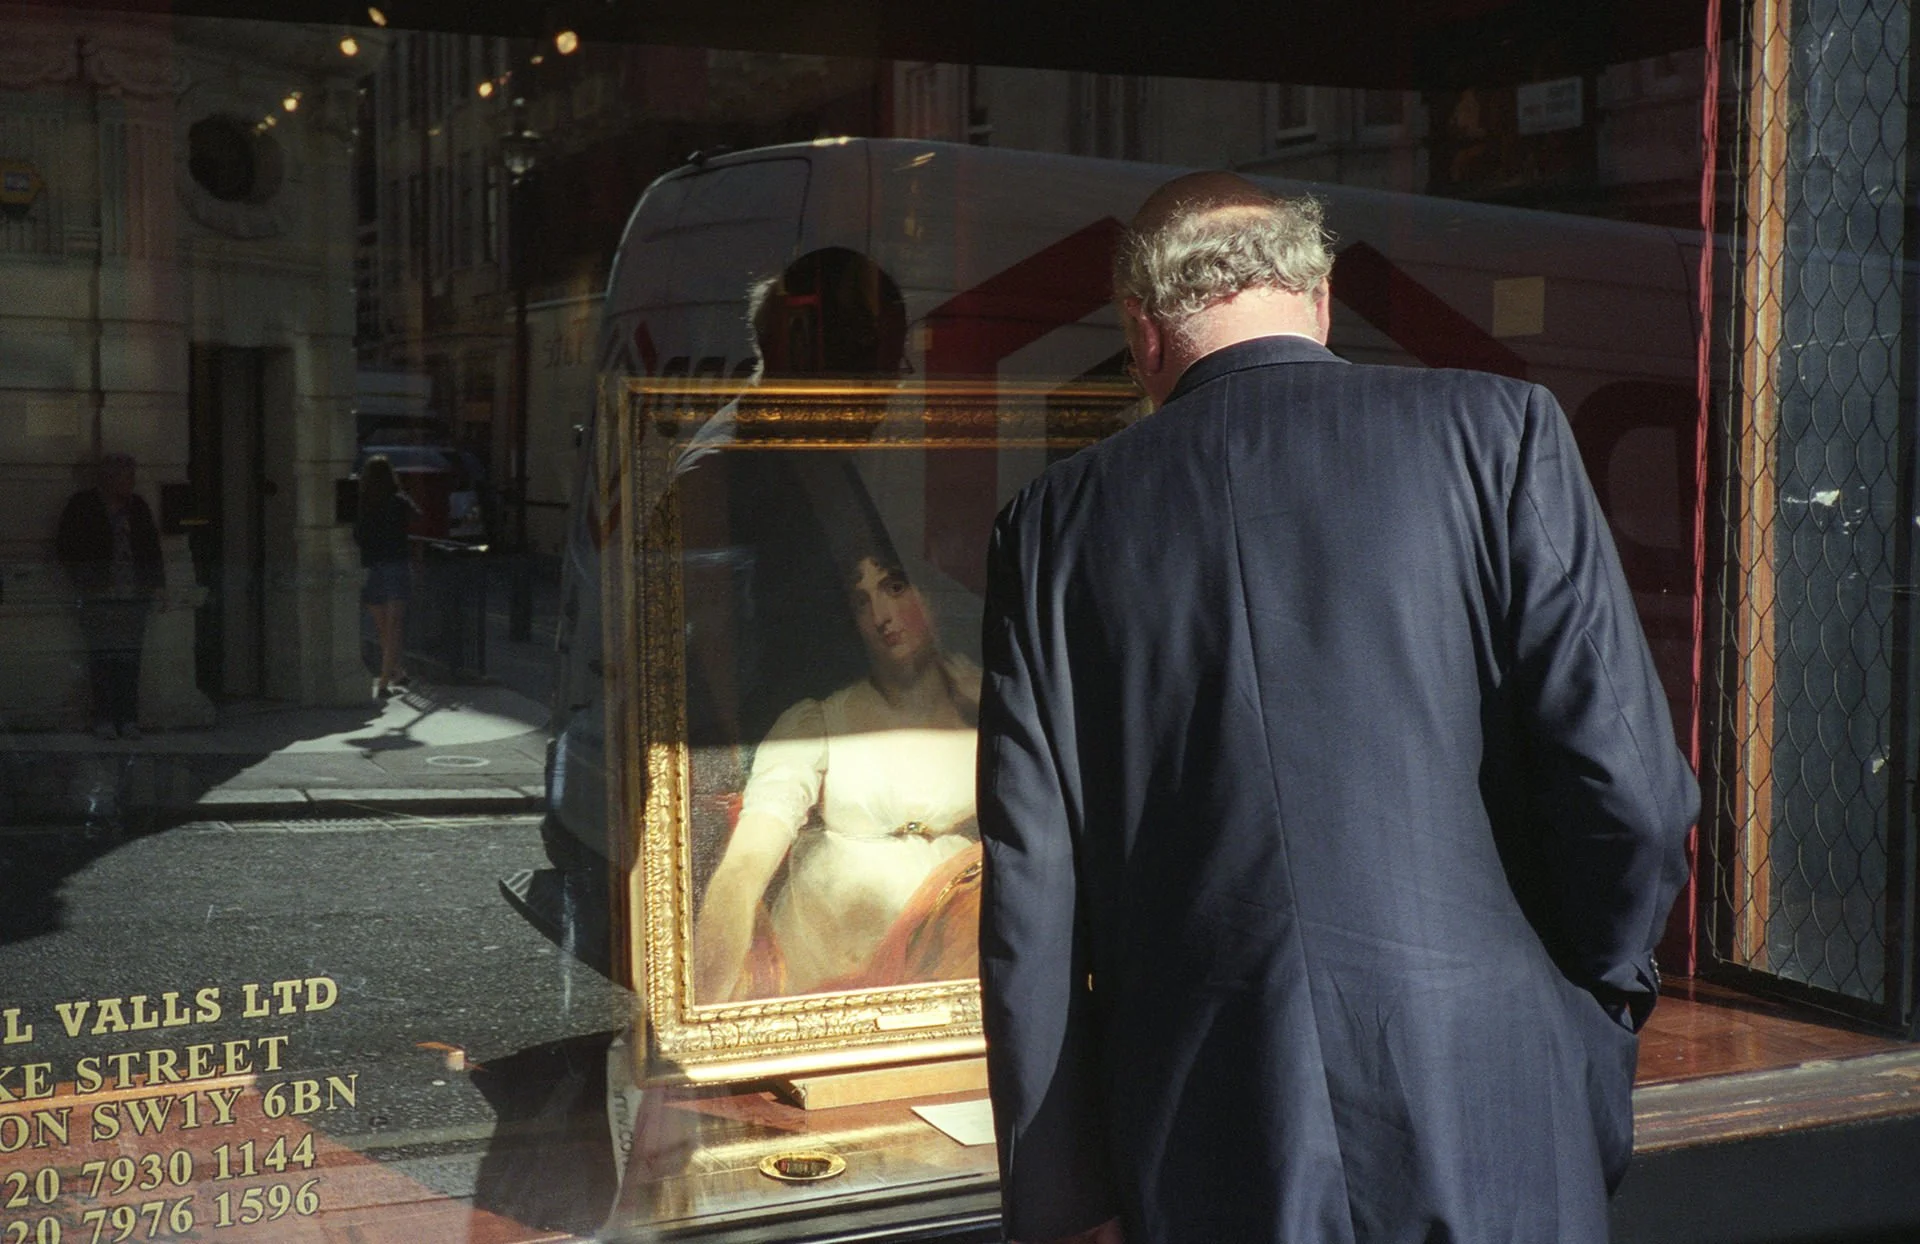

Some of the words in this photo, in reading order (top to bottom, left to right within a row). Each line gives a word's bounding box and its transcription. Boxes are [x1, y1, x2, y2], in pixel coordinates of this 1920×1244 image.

[55, 986, 222, 1038] VALLS
[242, 976, 339, 1019] LTD
[75, 1035, 290, 1094] STREET
[0, 1106, 72, 1152] ON
[92, 1086, 244, 1142] SW1Y
[263, 1073, 359, 1119] 6BN
[4, 1167, 61, 1209] 20
[81, 1148, 194, 1199] 7930
[213, 1131, 316, 1181] 1144
[6, 1216, 62, 1244] 20
[82, 1195, 195, 1244] 7976
[213, 1178, 320, 1229] 1596
